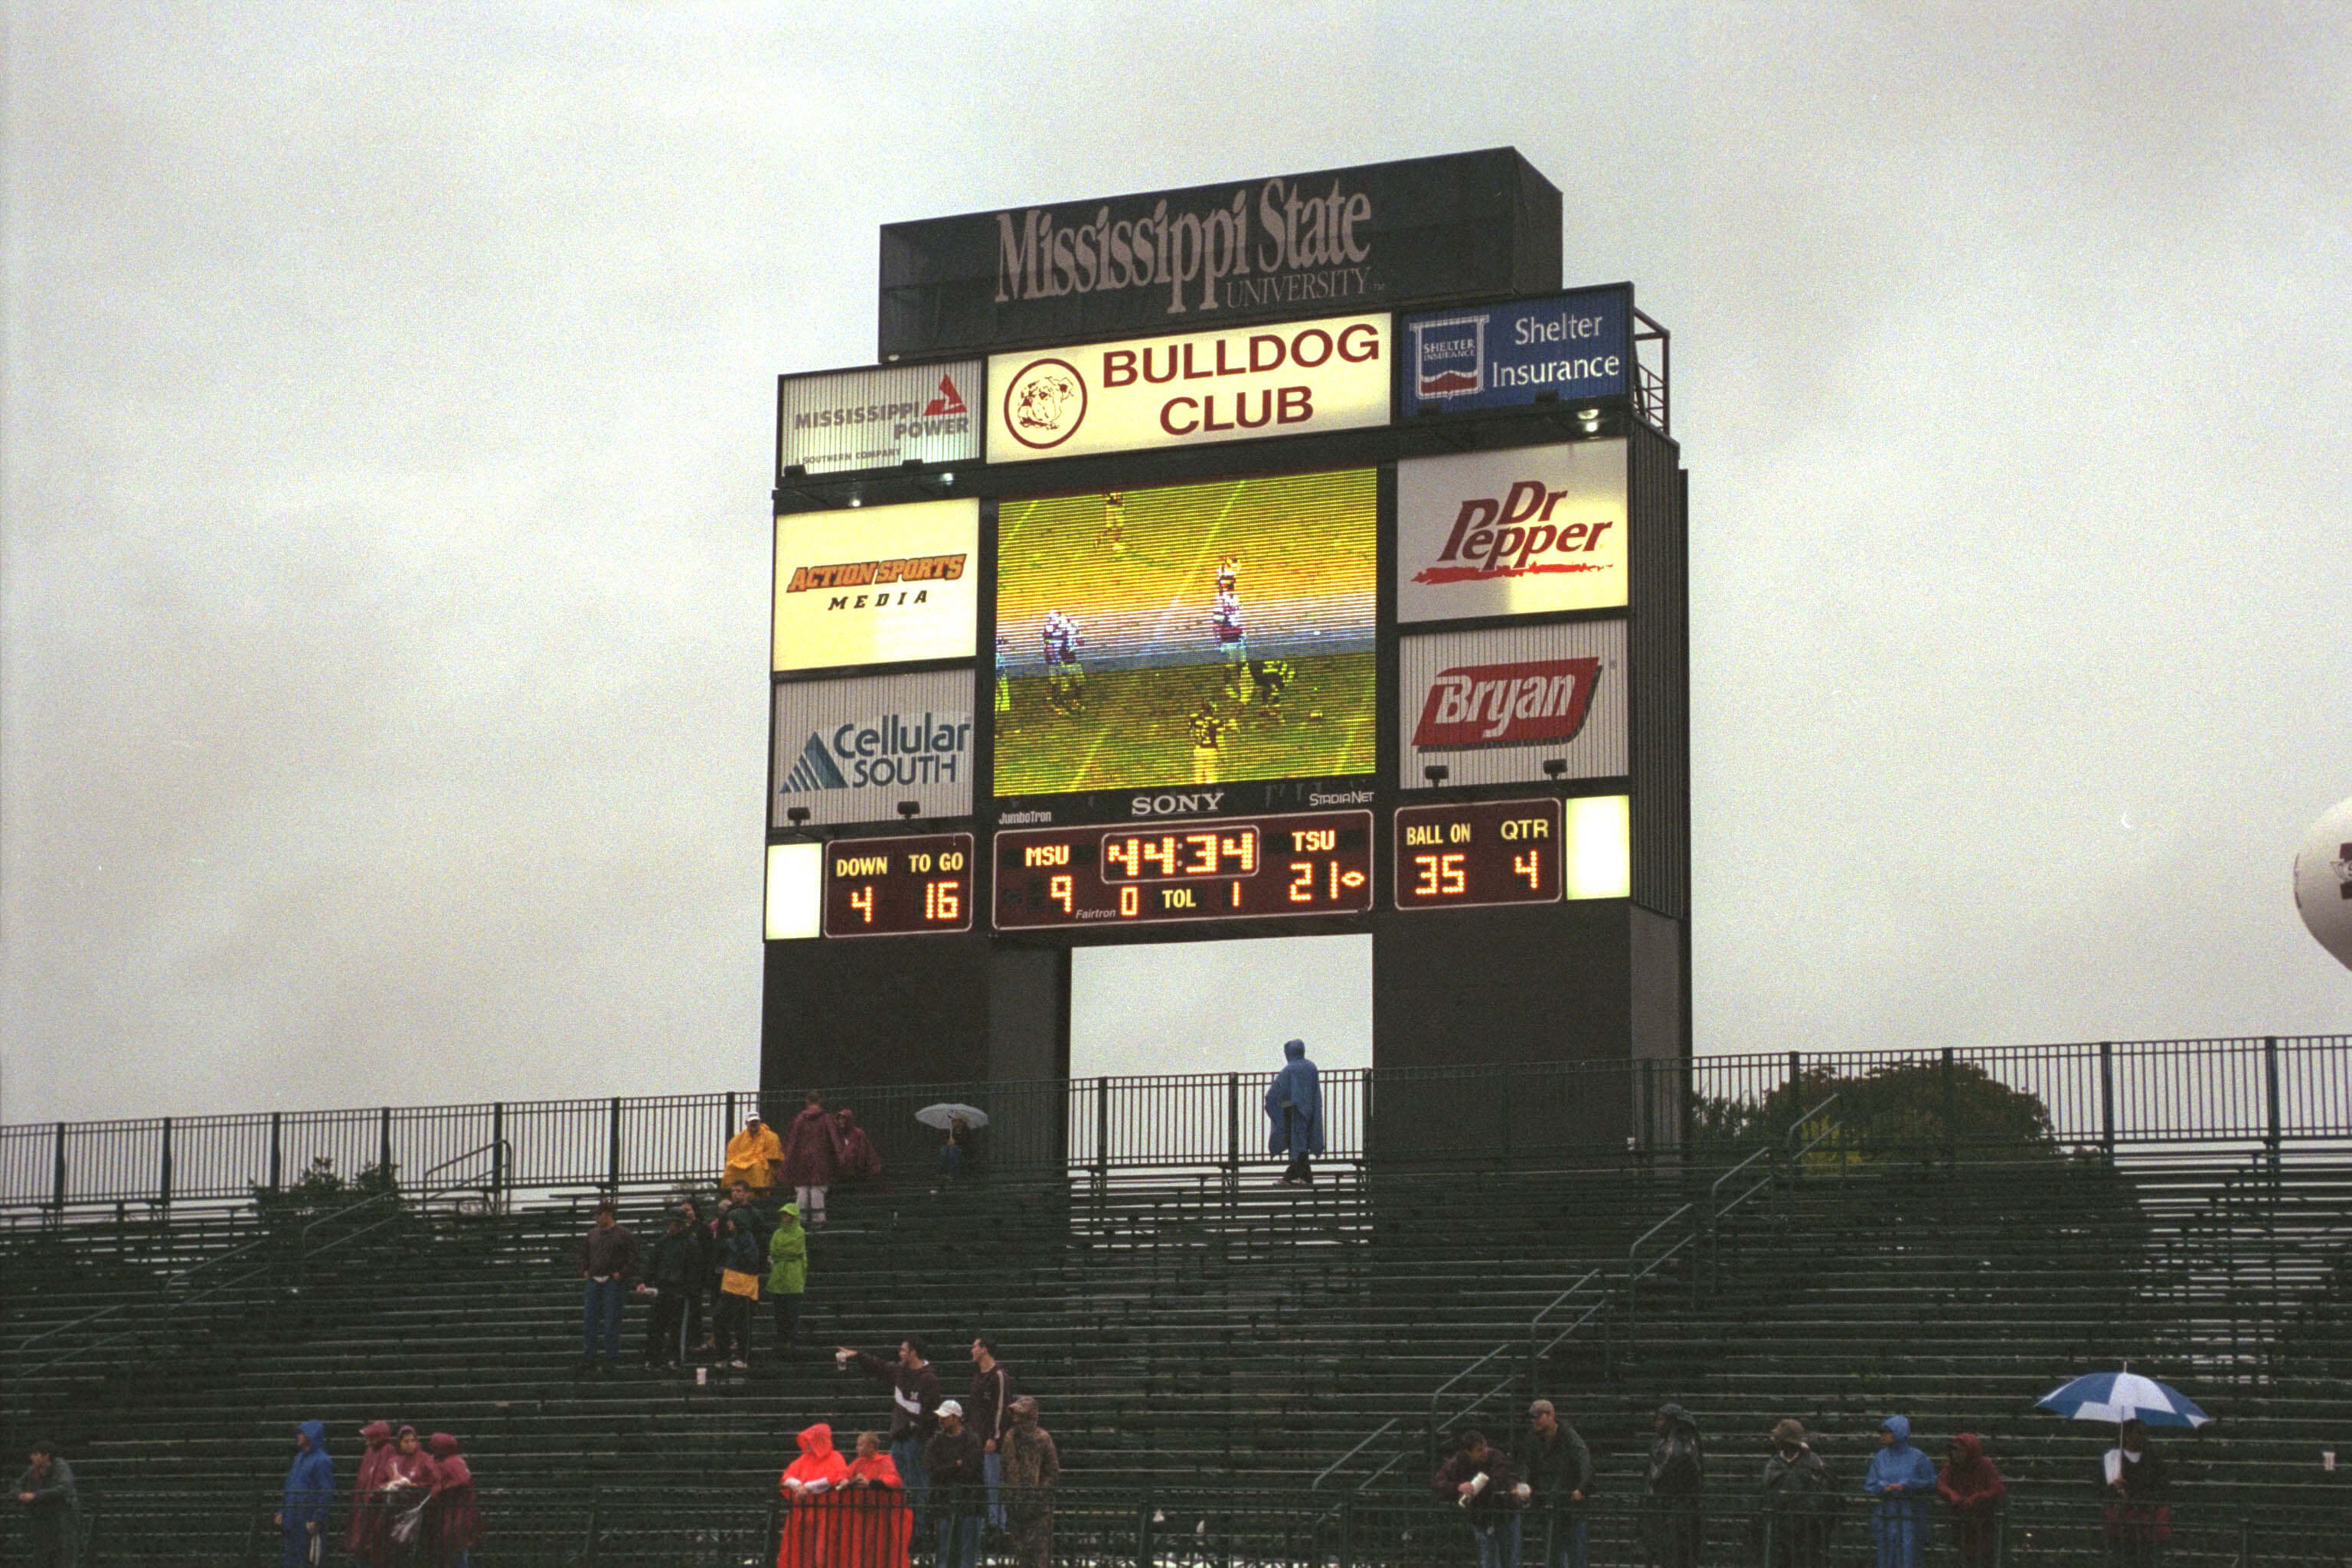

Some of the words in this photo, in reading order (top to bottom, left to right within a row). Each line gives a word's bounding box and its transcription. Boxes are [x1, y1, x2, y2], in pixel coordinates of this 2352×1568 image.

[995, 189, 1246, 313] Mississippi
[1258, 178, 1371, 272] State
[1227, 267, 1370, 308] UNIVERSITY
[1514, 312, 1603, 345] Shelter
[1102, 323, 1379, 388] BULLDOG
[1423, 338, 1475, 354] SHELTER
[1493, 355, 1620, 388] Insurance
[795, 402, 919, 430] MISSISSIPPI
[1160, 385, 1314, 436] CLUB
[893, 418, 969, 441] POWER
[854, 447, 901, 460] COMPANY
[1496, 480, 1568, 525] Dr
[1436, 498, 1613, 571] Pepper
[786, 561, 879, 593] ACTION
[874, 554, 967, 584] SPORTS
[828, 590, 928, 610] MEDIA
[1433, 672, 1576, 738] Bryan
[833, 712, 971, 759] Cellular
[853, 755, 956, 789] SOUTH
[1132, 792, 1224, 816] SONY
[1291, 830, 1336, 851] TSU
[1406, 825, 1443, 846] BALL
[1450, 823, 1471, 843] ON
[1501, 818, 1549, 841] QTR
[836, 856, 888, 877] DOWN
[909, 854, 930, 872] TO
[939, 852, 964, 871] GO
[1024, 845, 1070, 867] MSU
[1514, 850, 1537, 889] 4
[1289, 861, 1338, 901] 21
[1416, 854, 1465, 894] 35
[851, 886, 873, 922] 4
[926, 881, 959, 920] 16
[1050, 875, 1072, 913] 9
[1161, 889, 1197, 909] TOL
[1232, 881, 1240, 907] 1
[1075, 909, 1116, 920] Fairtron
